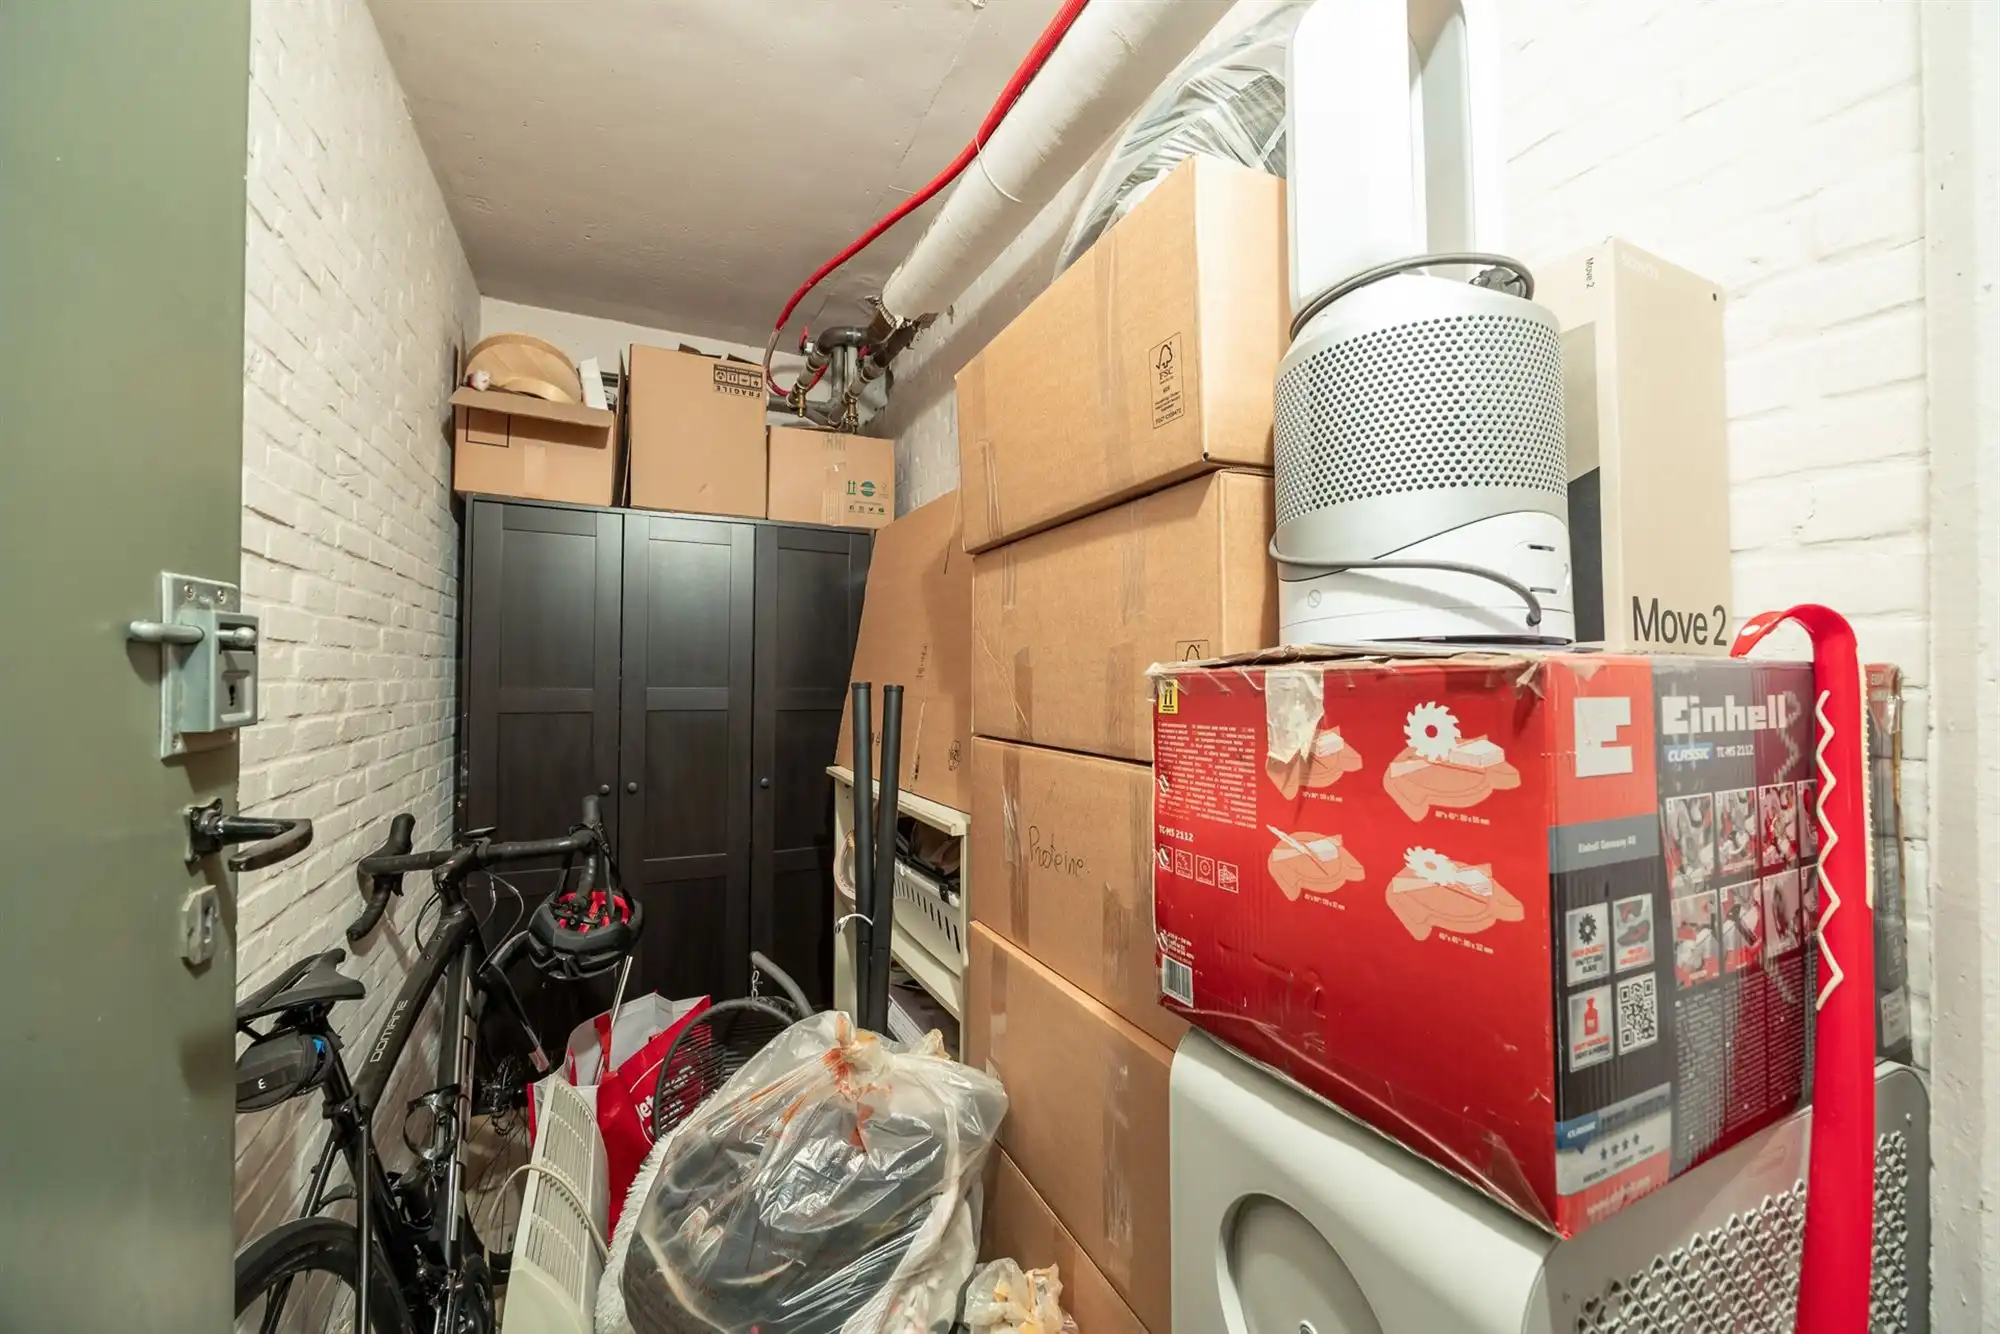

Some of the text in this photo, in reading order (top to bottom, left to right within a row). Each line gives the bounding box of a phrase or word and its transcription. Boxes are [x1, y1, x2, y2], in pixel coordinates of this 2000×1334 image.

[1585, 257, 1594, 281] Move
[1159, 365, 1173, 381] FSC
[716, 384, 761, 398] FRAGILE
[1632, 595, 1728, 647] Move 2
[1661, 694, 1788, 735] Einhell
[1667, 747, 1710, 763] CLASSIC
[1736, 744, 1755, 757] 2112
[1175, 827, 1194, 842] 2112
[369, 999, 409, 1063] DOMANE
